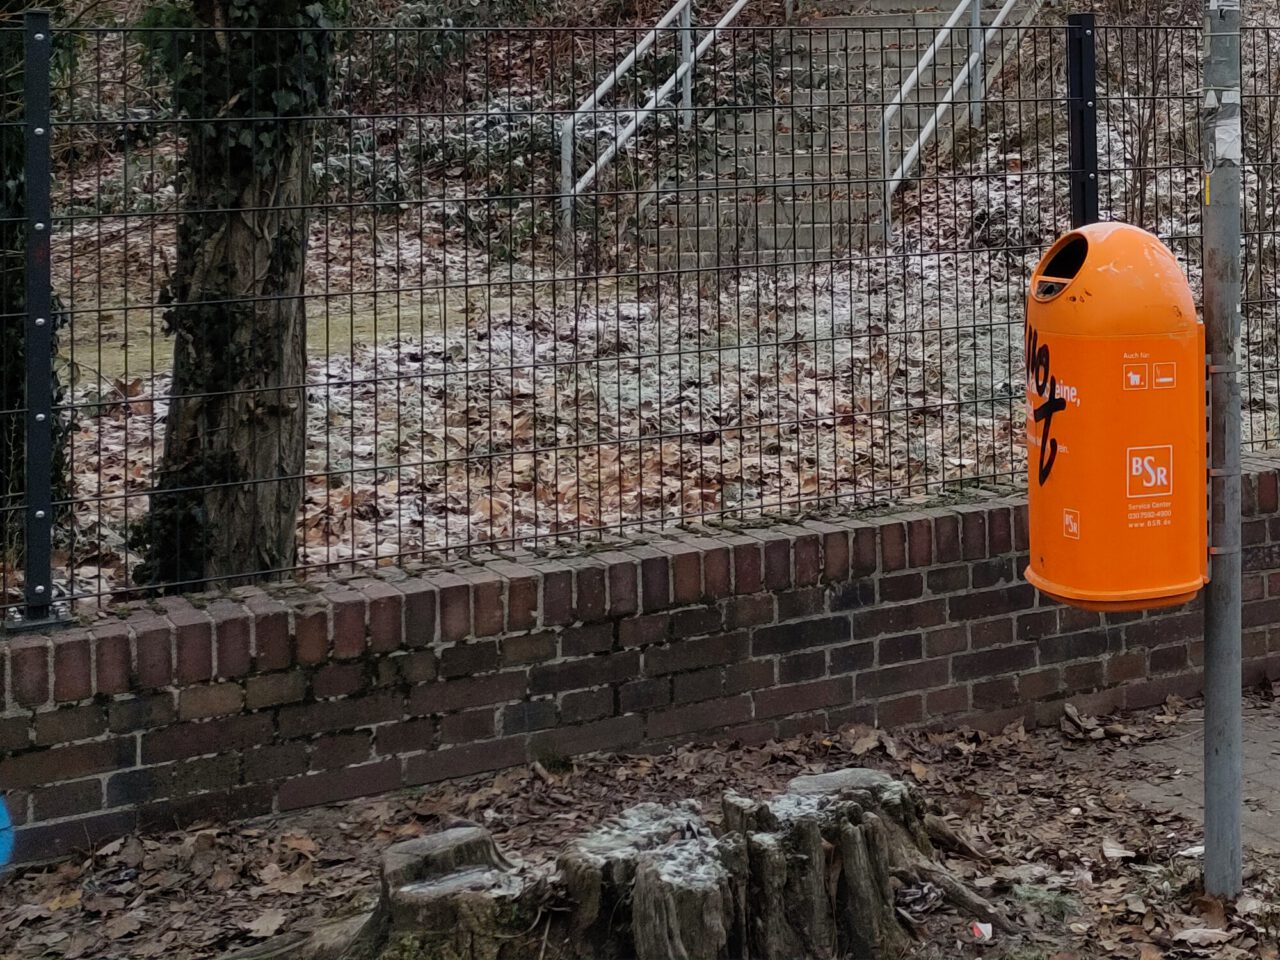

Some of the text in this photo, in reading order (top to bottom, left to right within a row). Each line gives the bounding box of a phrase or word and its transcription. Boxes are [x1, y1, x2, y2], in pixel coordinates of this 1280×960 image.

[1123, 351, 1140, 359] Auch
[1131, 455, 1169, 488] BSR
[1127, 502, 1151, 511] Service
